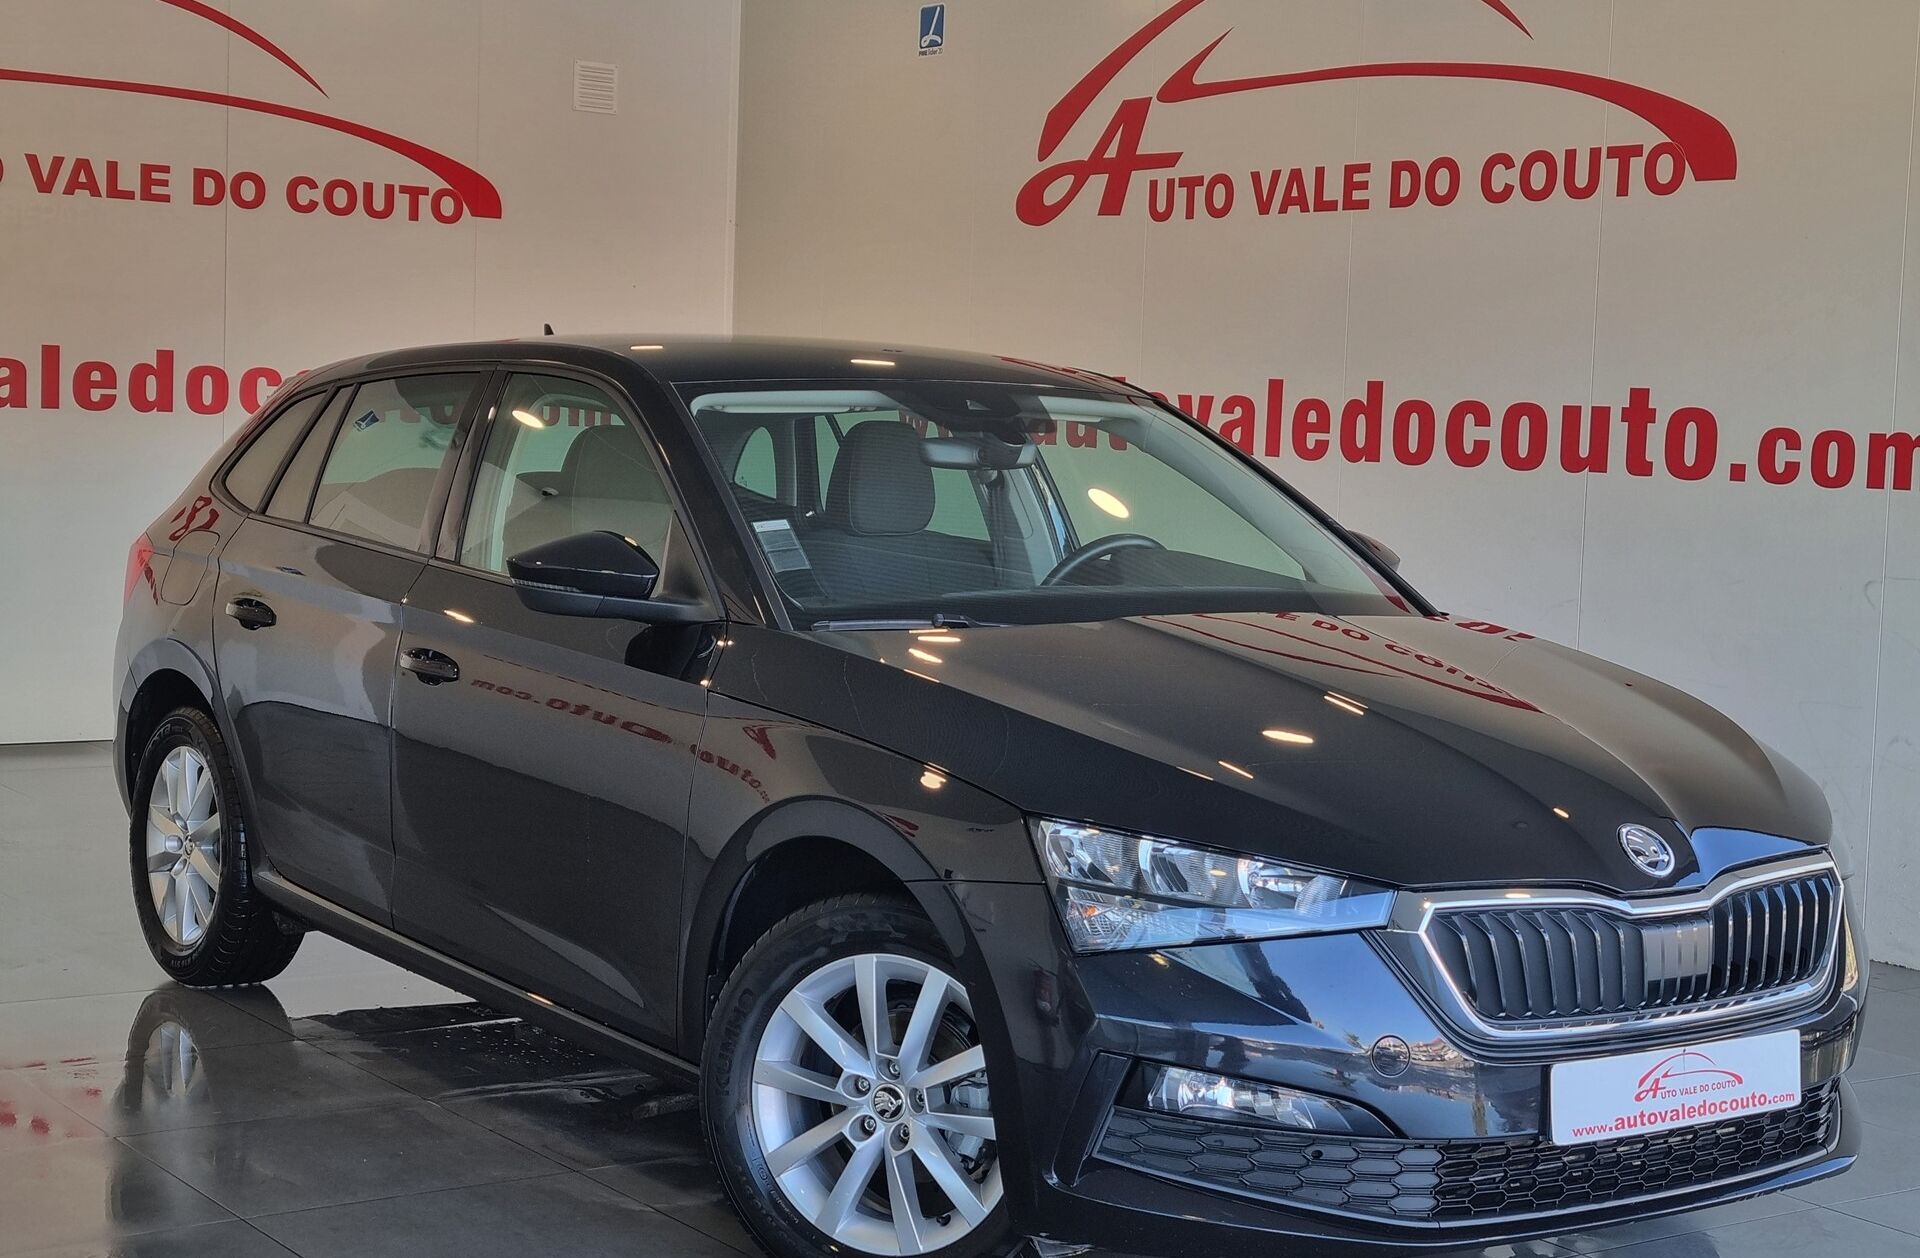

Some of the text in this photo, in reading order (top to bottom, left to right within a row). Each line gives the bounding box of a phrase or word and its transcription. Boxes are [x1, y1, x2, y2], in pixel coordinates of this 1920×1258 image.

[24, 153, 172, 203] VALE
[191, 167, 267, 210] DO
[285, 176, 463, 225] COUTO
[1016, 96, 1686, 228] AUTO VALE DO COUTO
[1572, 1091, 1796, 1138] www.autovaledocouto.com
[1634, 1076, 1737, 1103] AUTO VALE DO COUTO
